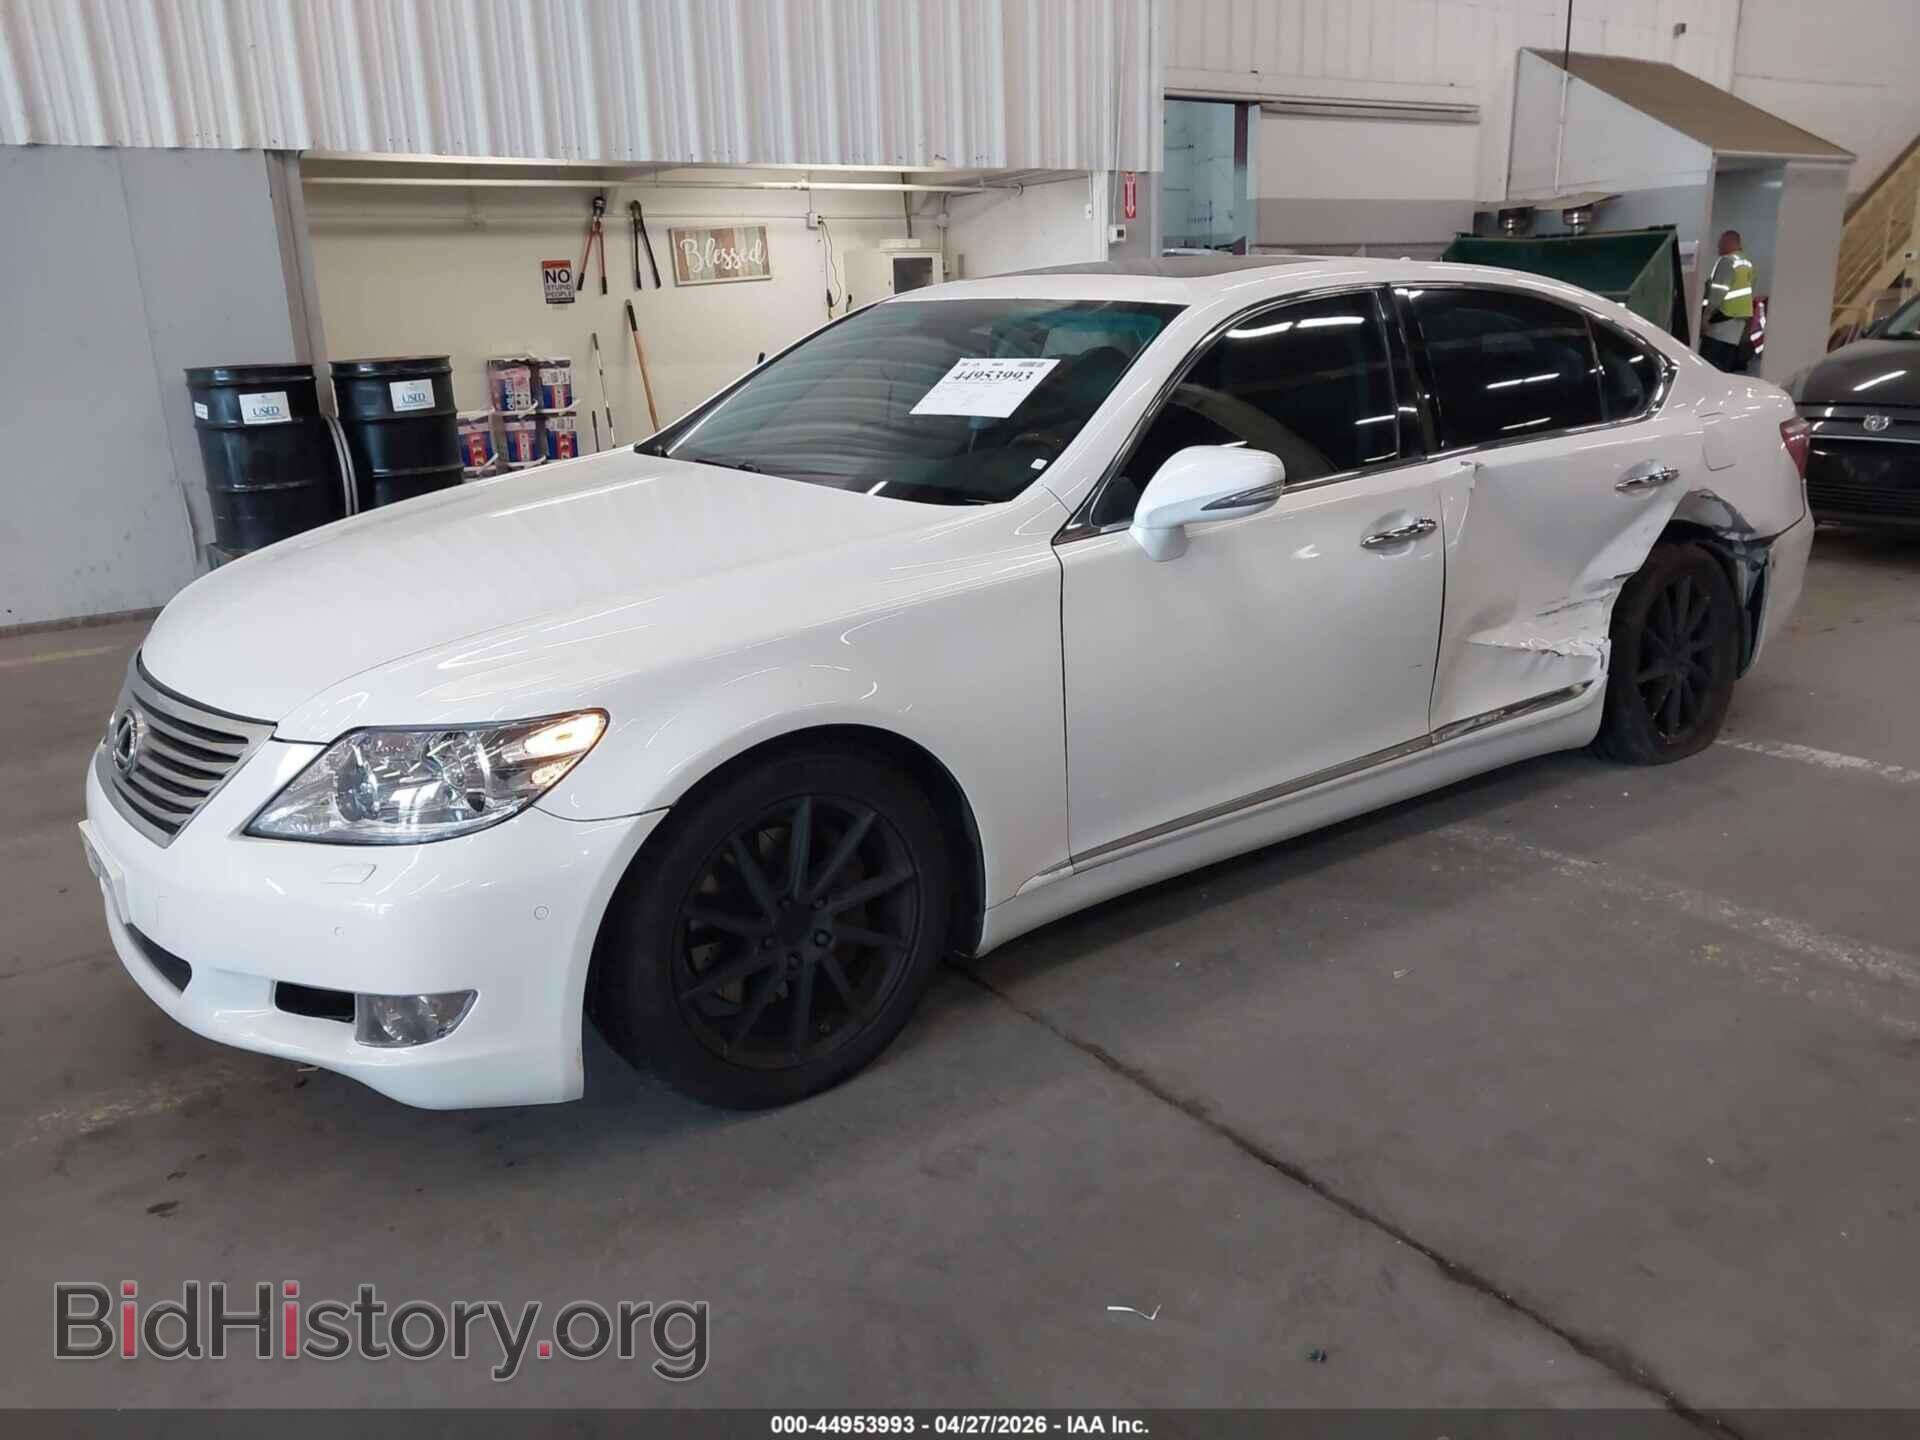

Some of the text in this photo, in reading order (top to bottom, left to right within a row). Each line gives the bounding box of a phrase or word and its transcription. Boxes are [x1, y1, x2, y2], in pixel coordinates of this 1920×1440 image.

[680, 238, 766, 273] Blessed
[545, 269, 570, 283] NO
[400, 392, 426, 403] USED
[252, 406, 280, 417] USED
